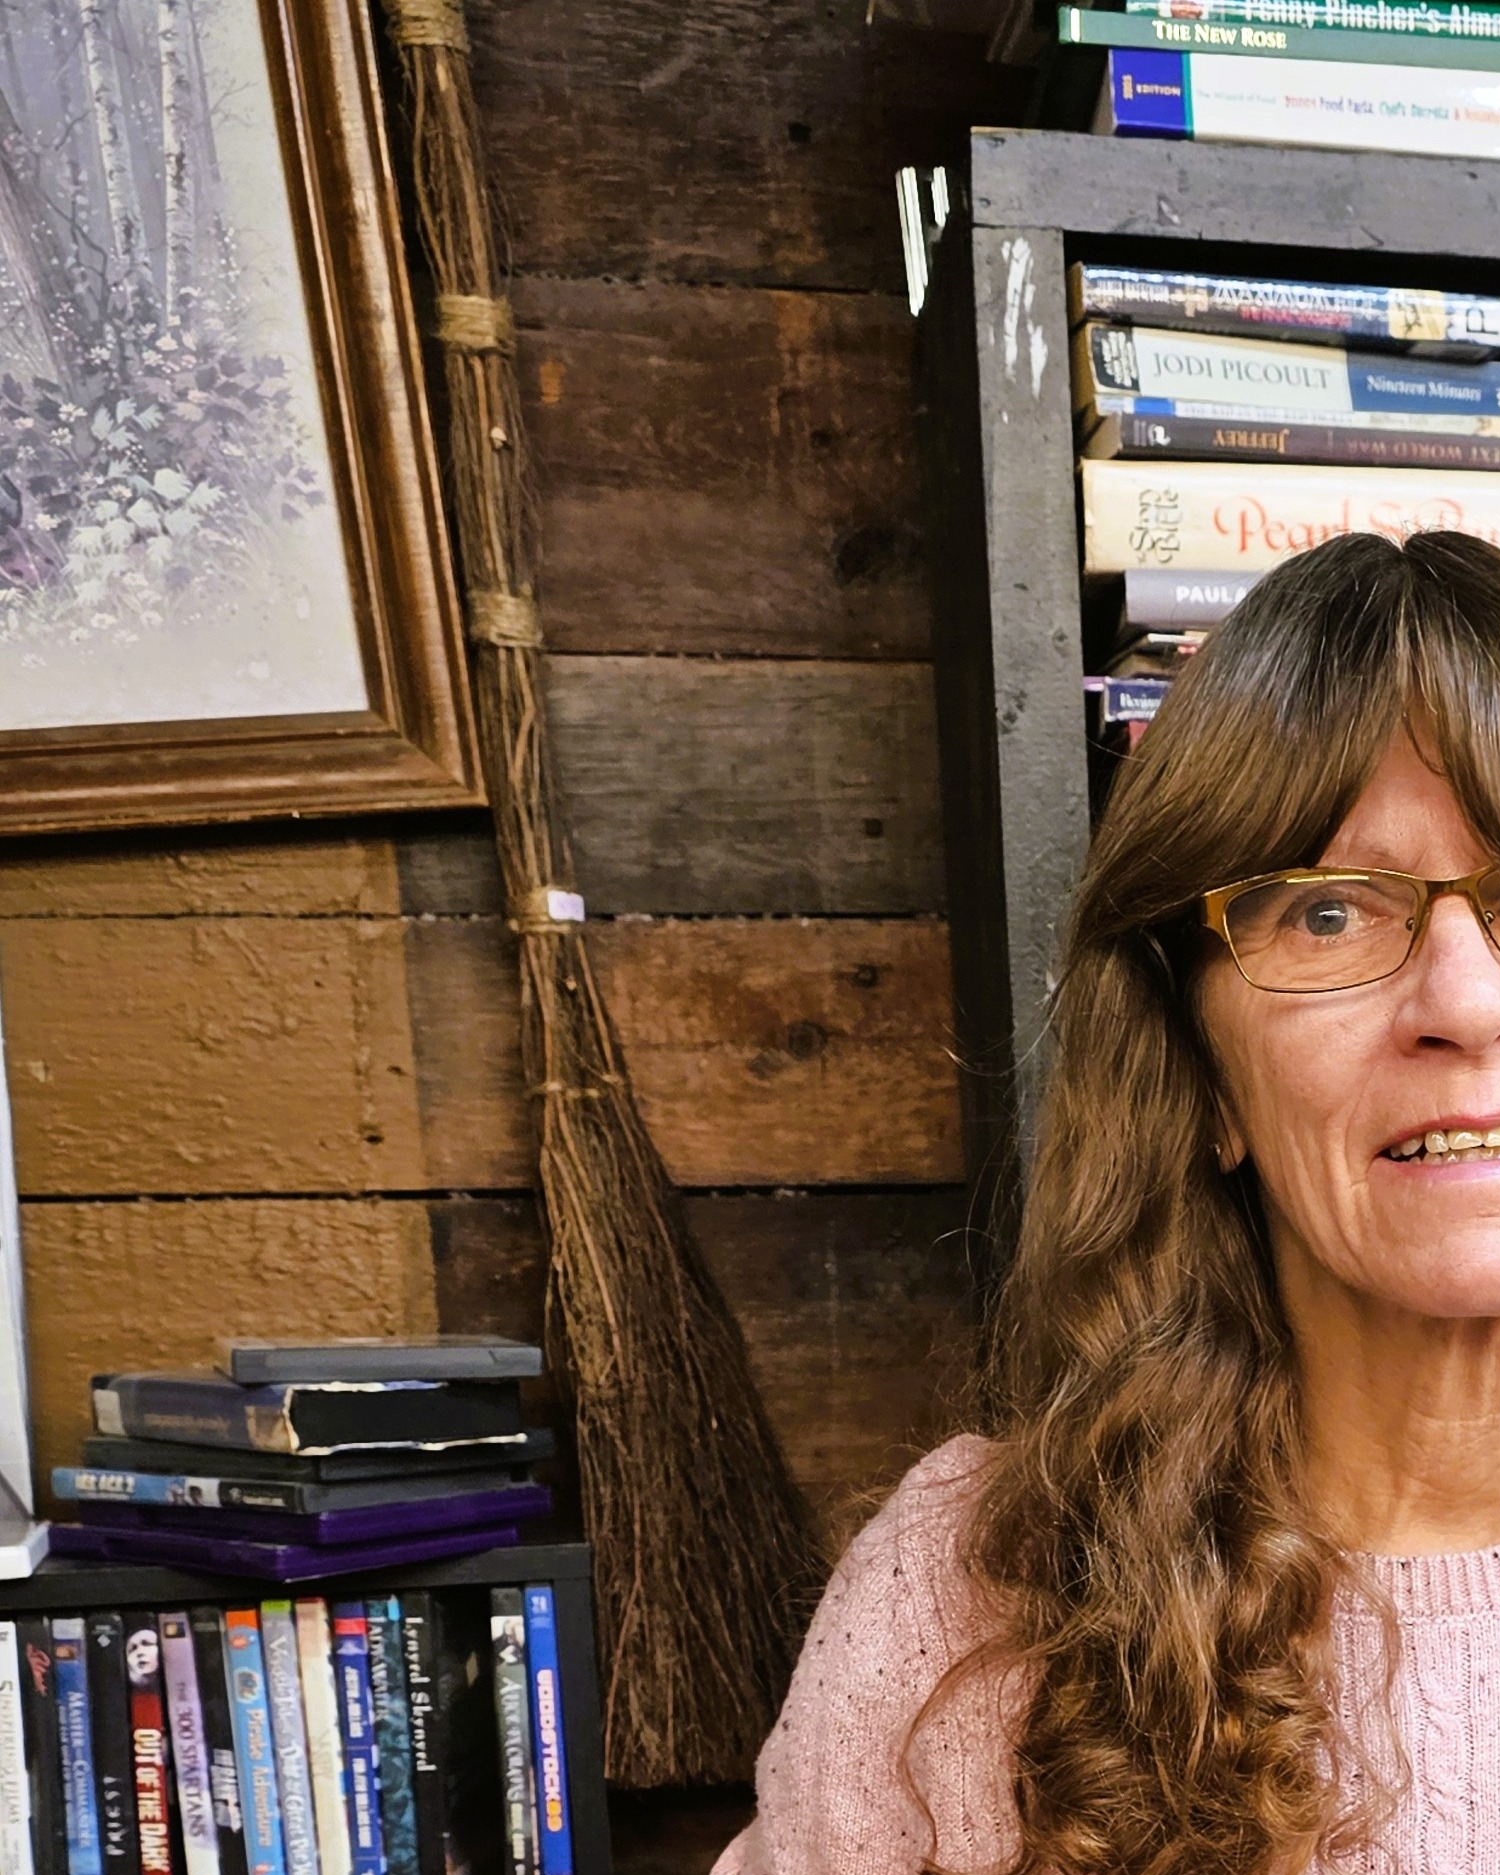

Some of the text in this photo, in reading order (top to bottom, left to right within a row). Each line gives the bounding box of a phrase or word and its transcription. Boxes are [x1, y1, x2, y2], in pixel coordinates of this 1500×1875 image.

[1152, 21, 1288, 49] THE NEW ROSE
[1326, 1, 1441, 33] Pincher's
[1154, 354, 1330, 389] JODI PICOULT
[1213, 429, 1290, 453] JEFFREY
[68, 1691, 85, 1747] MASTER
[405, 1616, 437, 1772] Lynyrd Skynyrd
[176, 1706, 205, 1838] 300 SPARTANS
[247, 1708, 272, 1847] Pirate Adventure
[133, 1728, 170, 1873] OUT OF THE DARK
